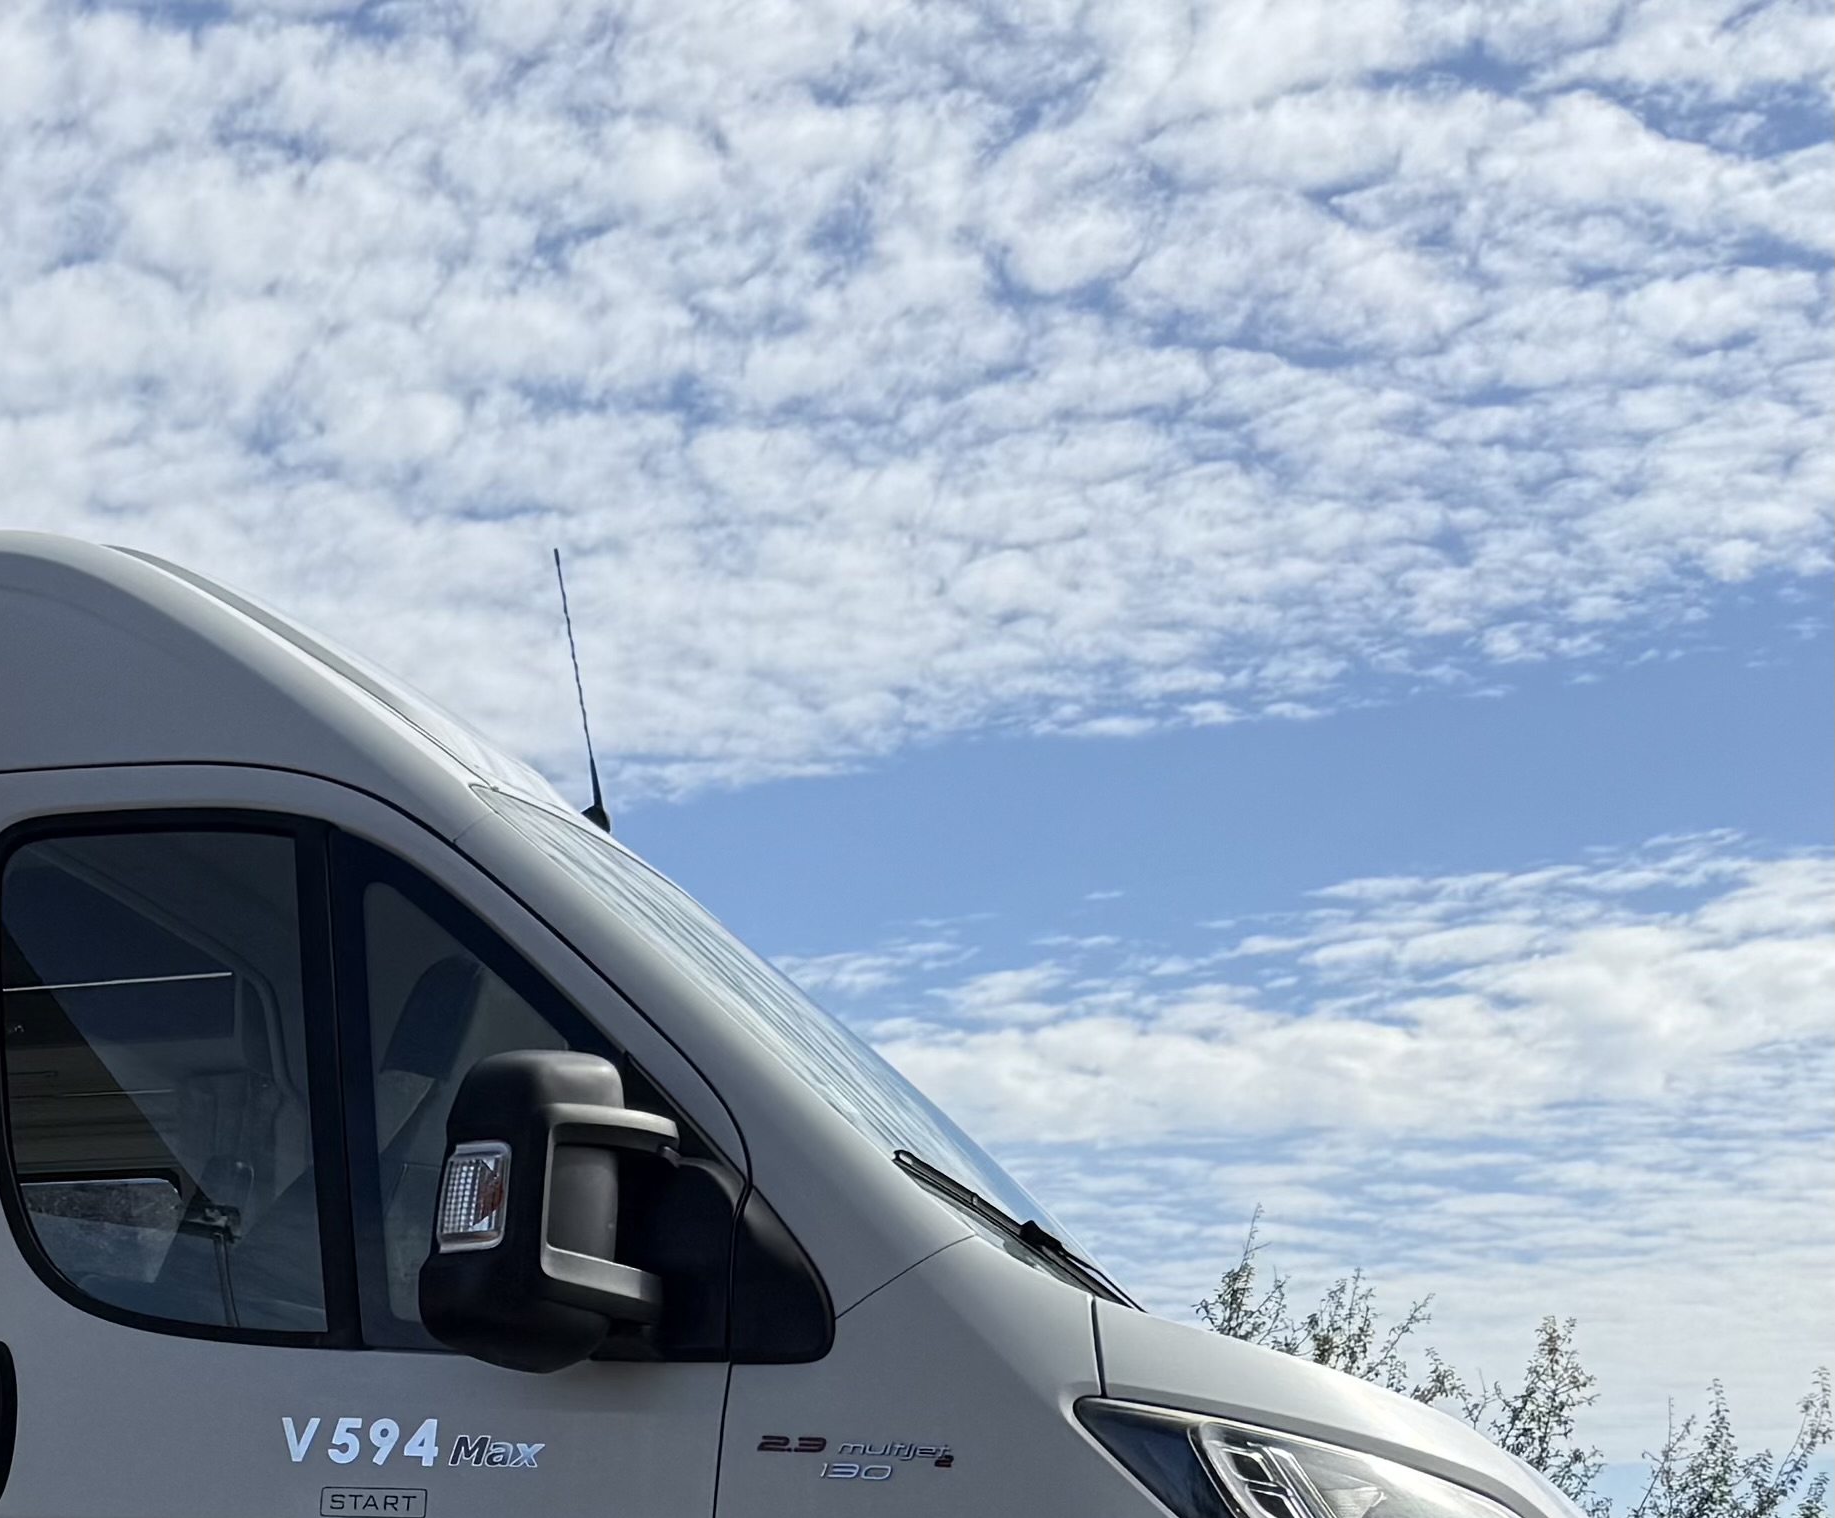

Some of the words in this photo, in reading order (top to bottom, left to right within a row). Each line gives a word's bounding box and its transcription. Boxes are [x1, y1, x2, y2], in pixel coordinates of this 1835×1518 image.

[448, 1434, 545, 1468] Max
[757, 1435, 827, 1453] 2.3
[820, 1462, 893, 1481] 130
[330, 1494, 418, 1512] START
